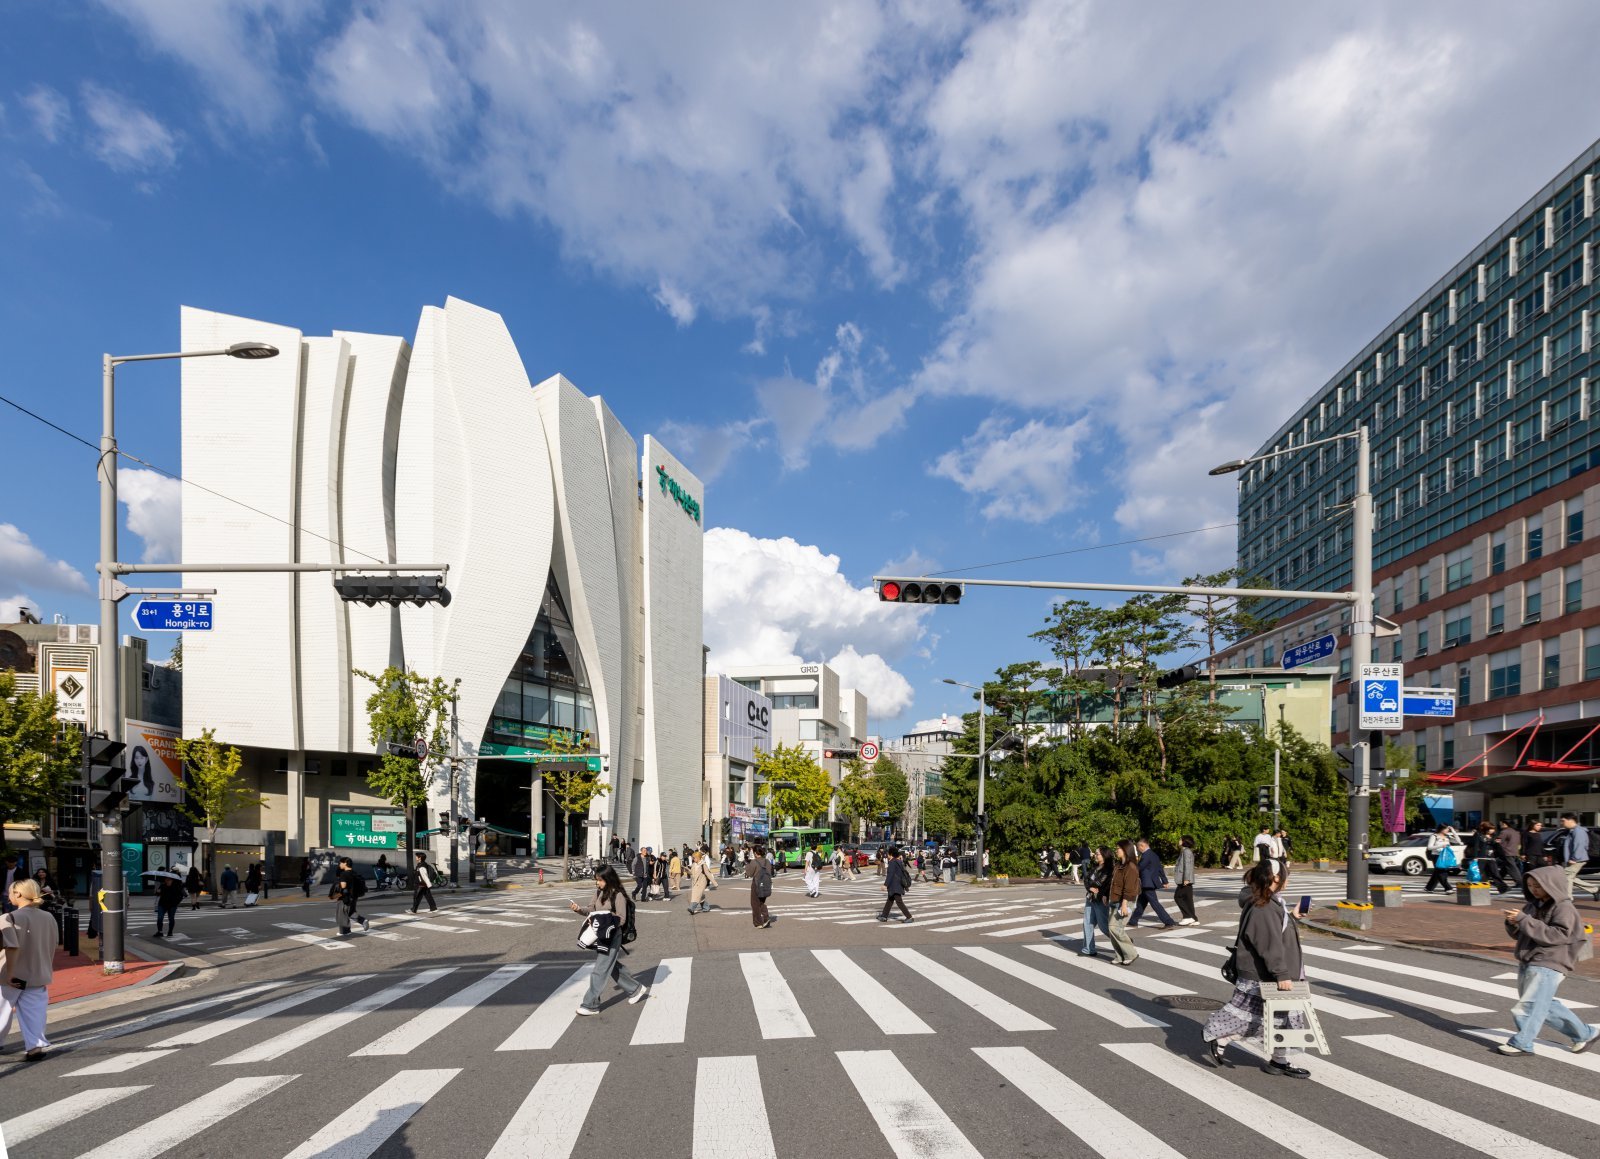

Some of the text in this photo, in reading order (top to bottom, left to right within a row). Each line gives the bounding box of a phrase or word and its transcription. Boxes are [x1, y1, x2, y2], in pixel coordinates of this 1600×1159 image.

[172, 604, 209, 617] 홍익로
[165, 619, 209, 628] Hongik-ro
[1295, 642, 1320, 656] 와우산로
[1363, 667, 1400, 676] 와우산로
[748, 700, 768, 727] C&C
[1363, 716, 1400, 724] 자전거우선도로
[155, 749, 177, 759] OPEN
[345, 819, 365, 827] 하나은행
[357, 834, 386, 844] 하나은행
